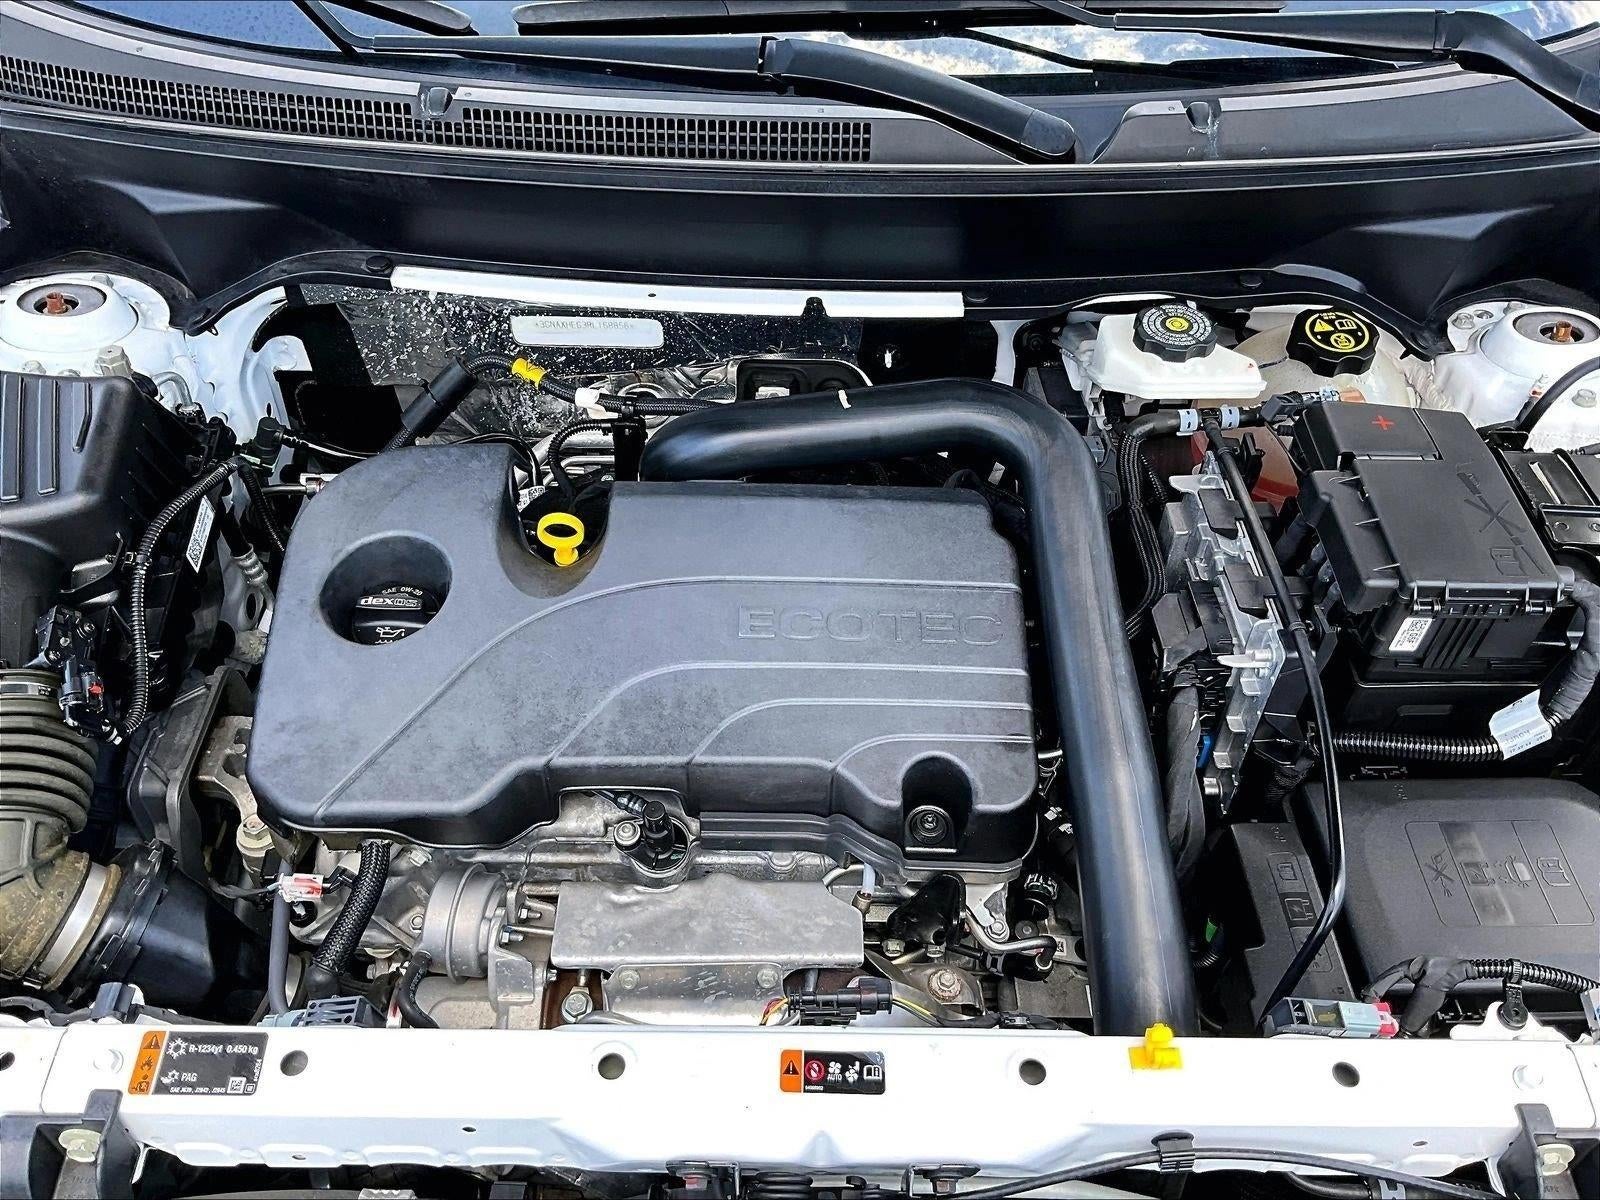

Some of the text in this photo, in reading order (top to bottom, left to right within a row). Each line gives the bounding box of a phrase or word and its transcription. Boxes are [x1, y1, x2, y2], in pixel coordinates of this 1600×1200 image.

[381, 587, 397, 596] SAE
[360, 596, 418, 607] dexos
[738, 605, 1004, 646] ECOTEC
[226, 1044, 247, 1054] 0.450
[248, 1044, 259, 1055] kg
[180, 1072, 198, 1082] PAG
[827, 1073, 843, 1081] AUTO
